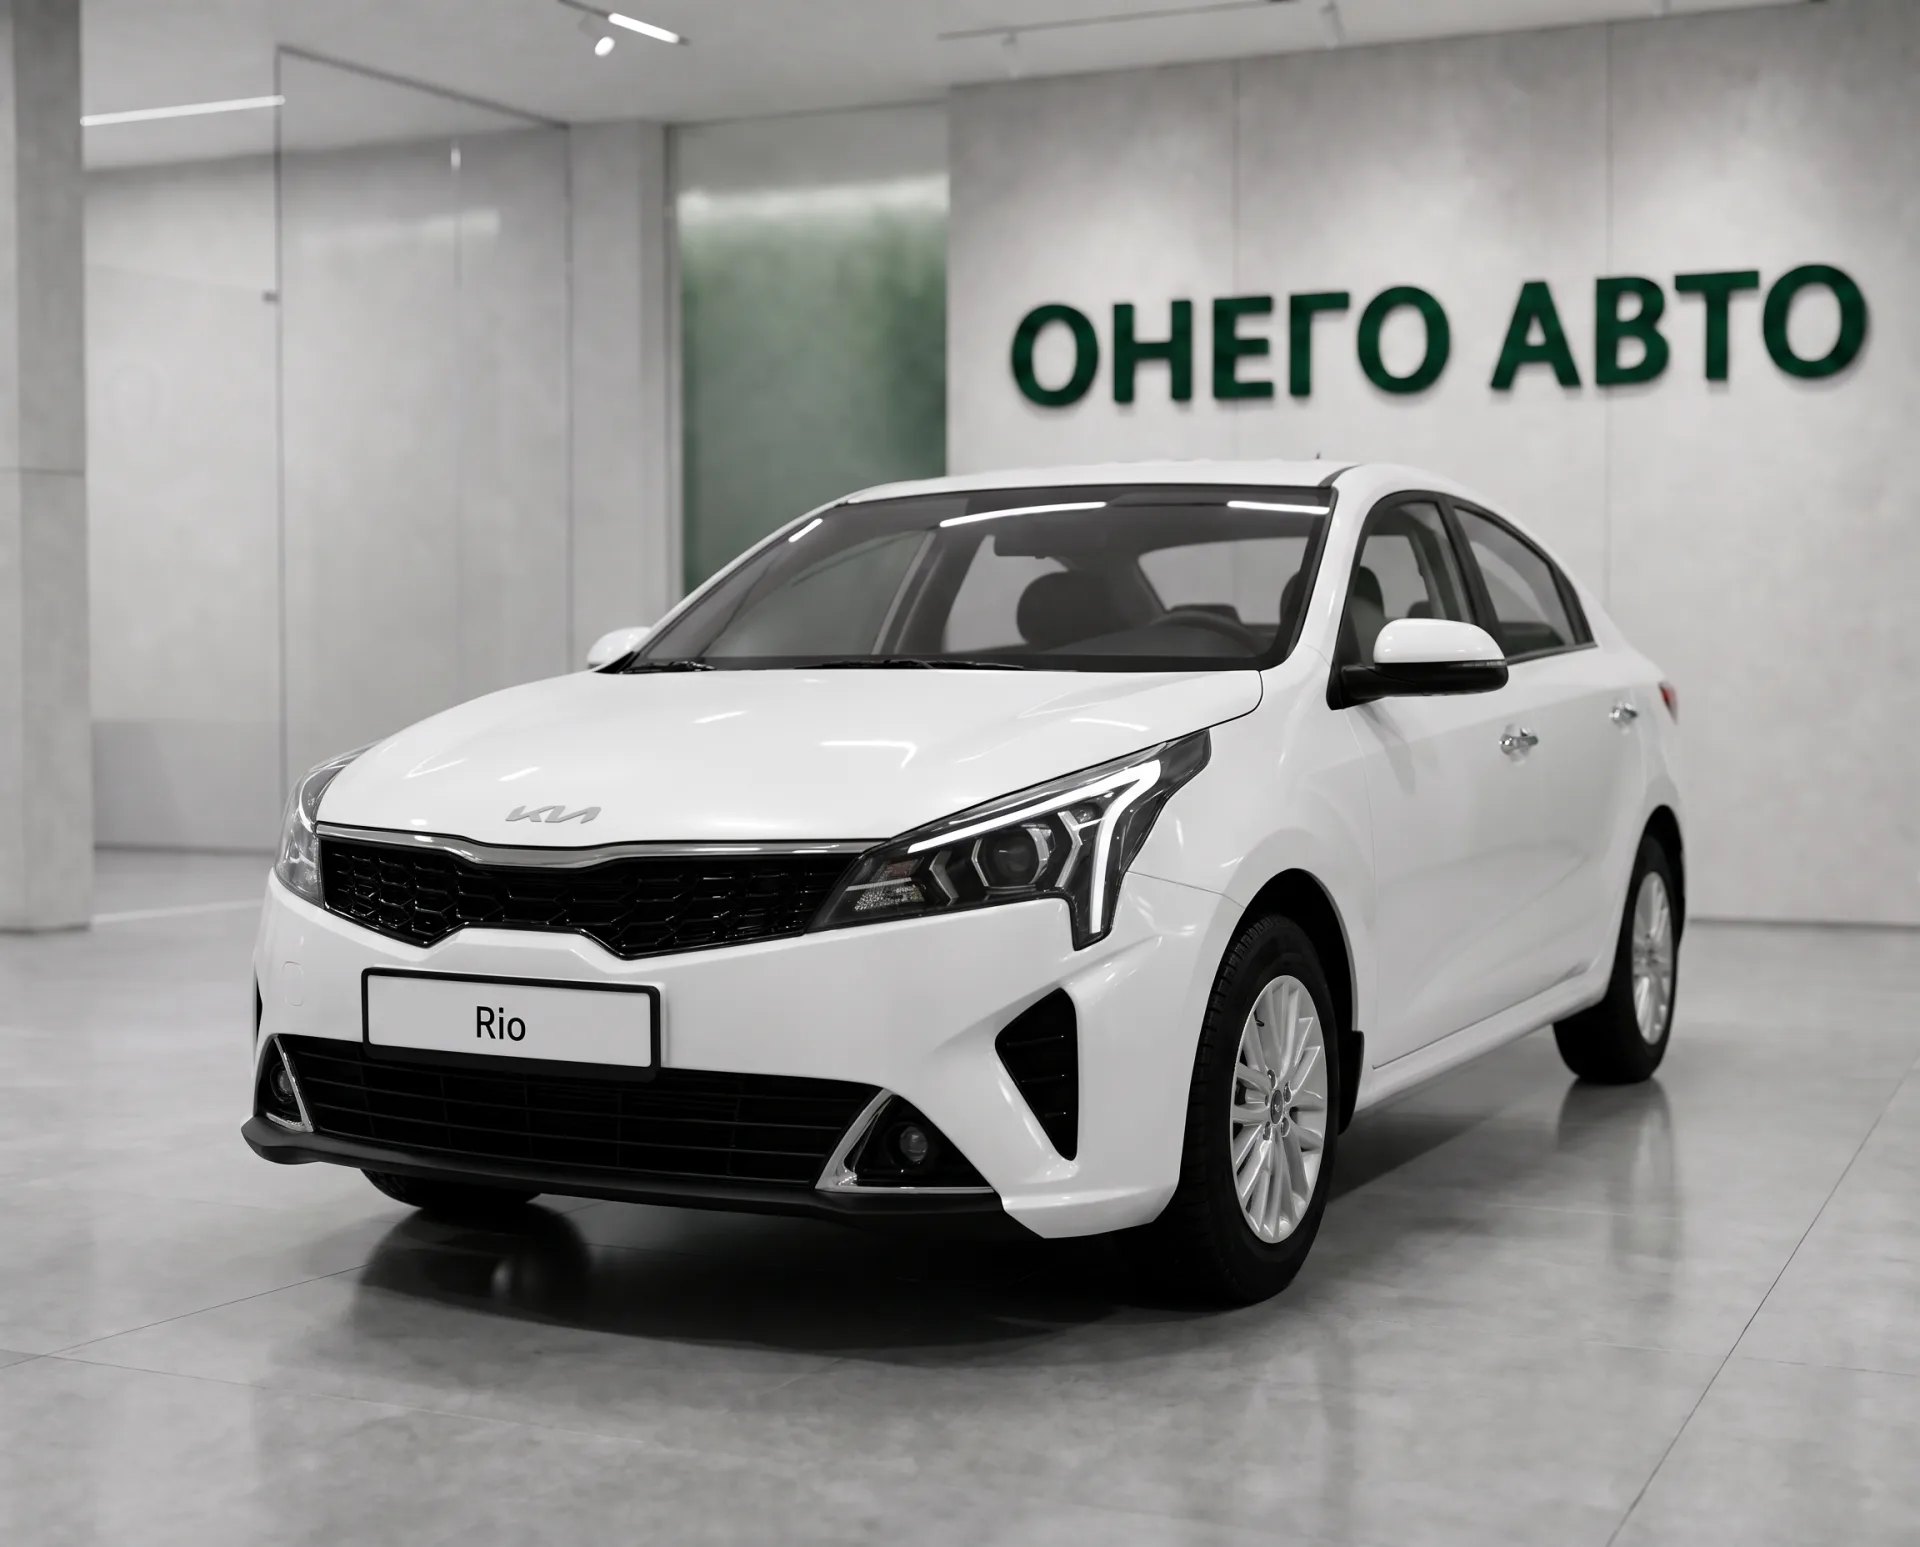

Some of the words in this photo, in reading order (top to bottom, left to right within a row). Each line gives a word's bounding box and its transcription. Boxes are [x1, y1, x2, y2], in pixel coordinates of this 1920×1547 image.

[1011, 286, 1451, 406] ОНЕГО
[1490, 263, 1868, 389] АВТО
[475, 1005, 527, 1042] Rio
